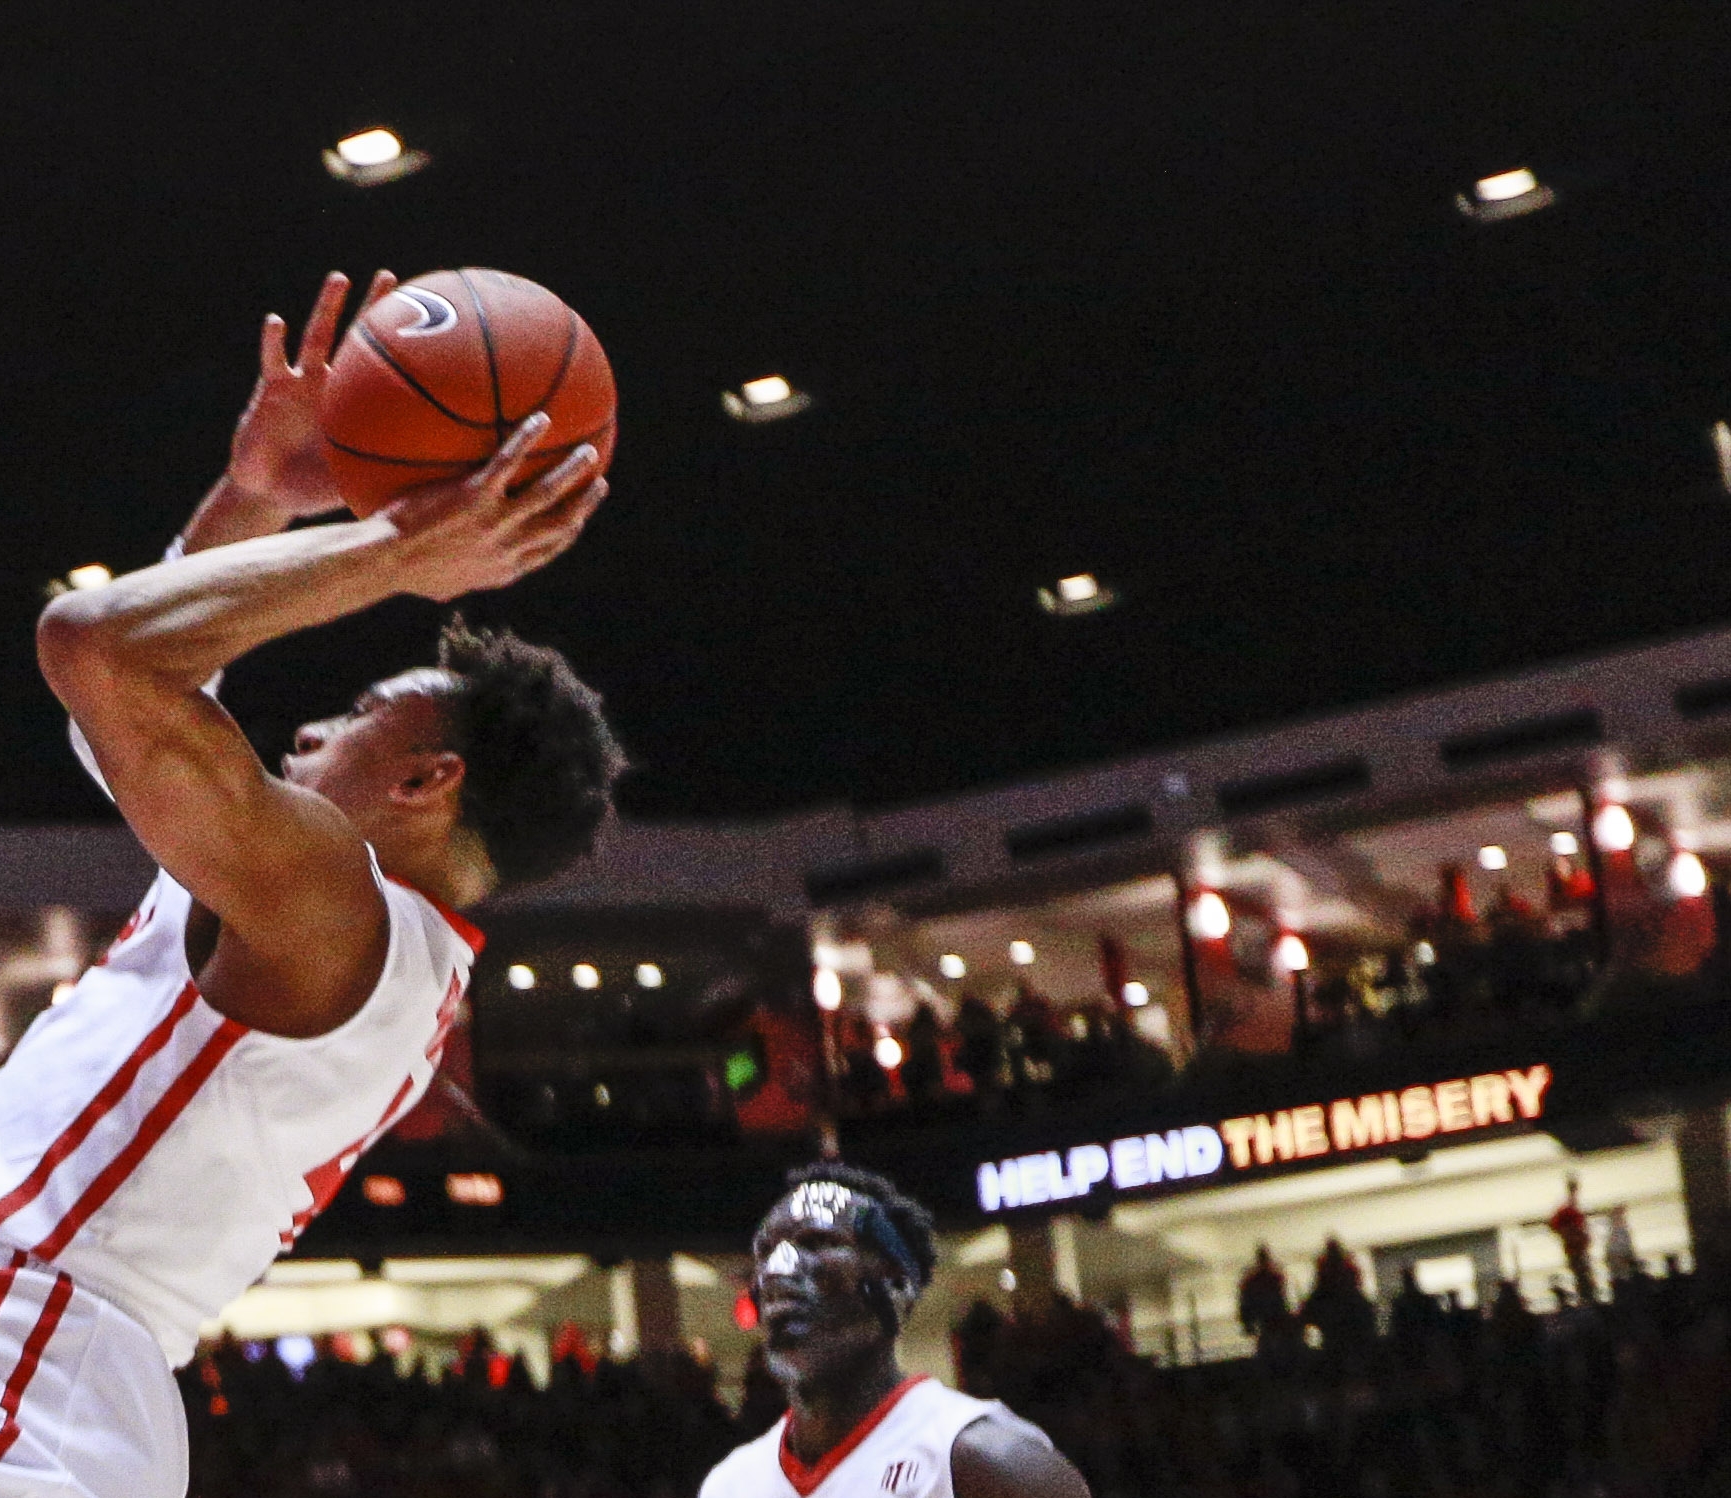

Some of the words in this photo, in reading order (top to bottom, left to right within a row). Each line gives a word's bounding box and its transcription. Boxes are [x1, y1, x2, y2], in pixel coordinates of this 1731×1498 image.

[976, 1142, 1110, 1212] HELP
[1111, 1124, 1224, 1190] END
[1220, 1103, 1330, 1171] THE
[1330, 1063, 1553, 1152] MISERY
